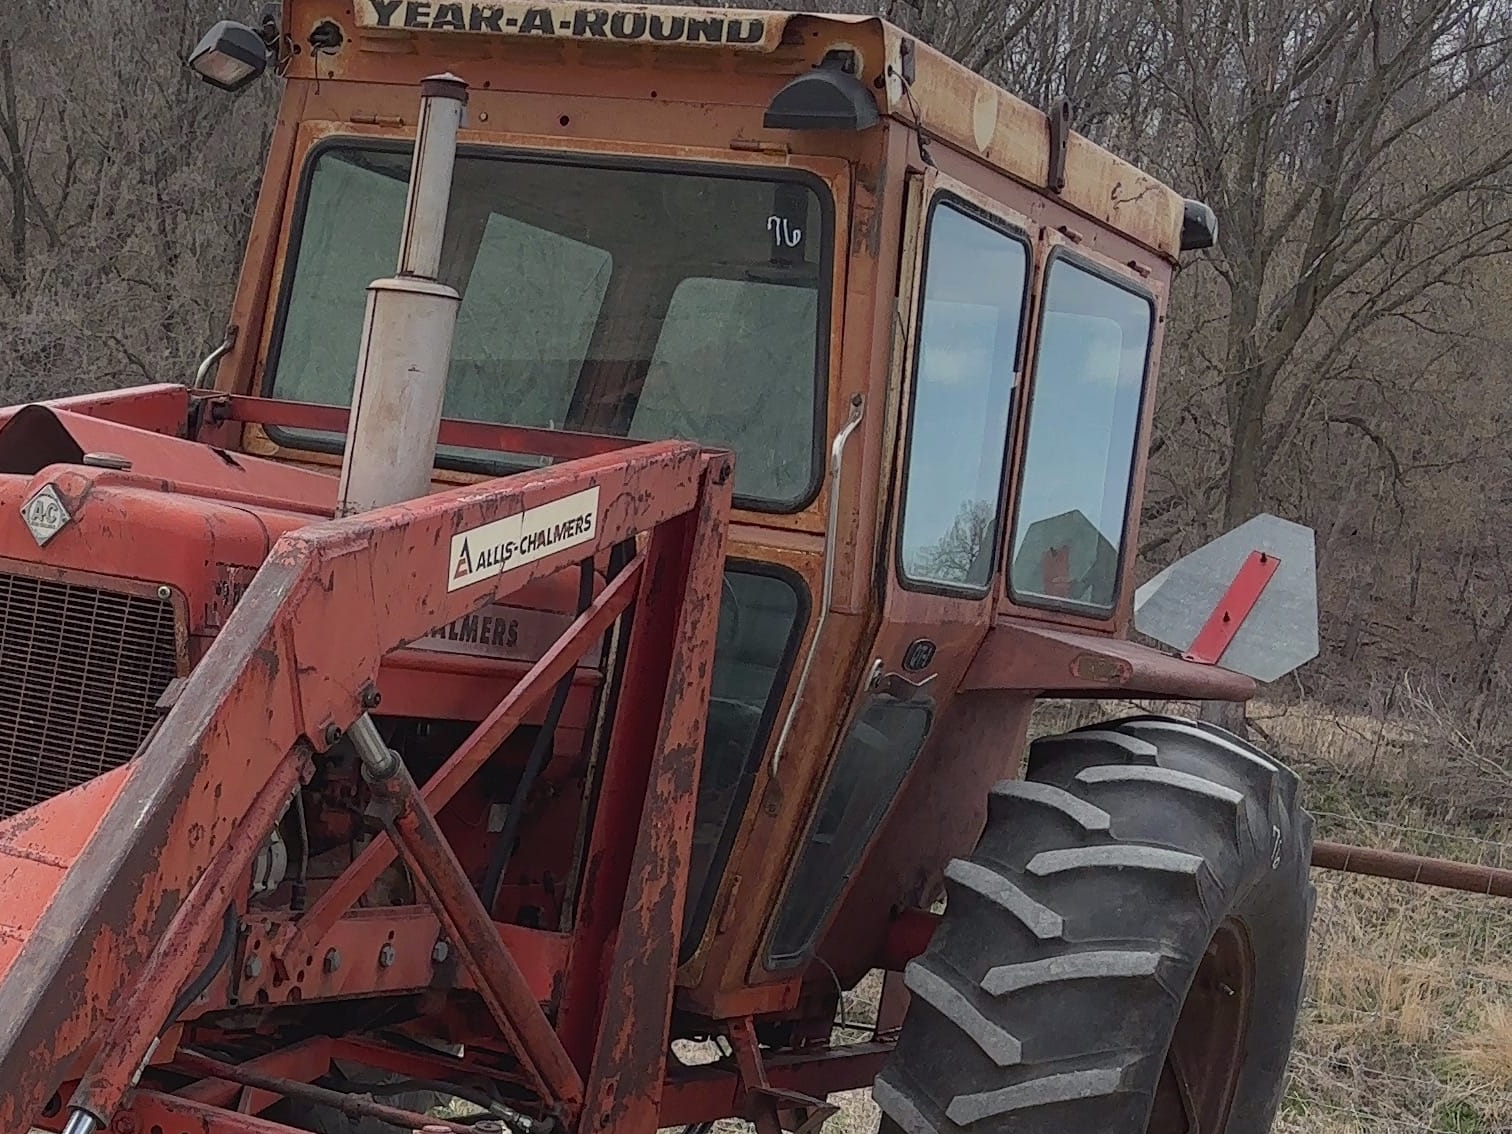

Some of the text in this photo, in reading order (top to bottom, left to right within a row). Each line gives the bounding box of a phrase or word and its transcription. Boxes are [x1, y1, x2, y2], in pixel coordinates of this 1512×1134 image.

[369, 0, 767, 44] YEAR-A-ROUND
[767, 215, 802, 247] 76
[475, 512, 593, 572] ALLIS-CHALMERS
